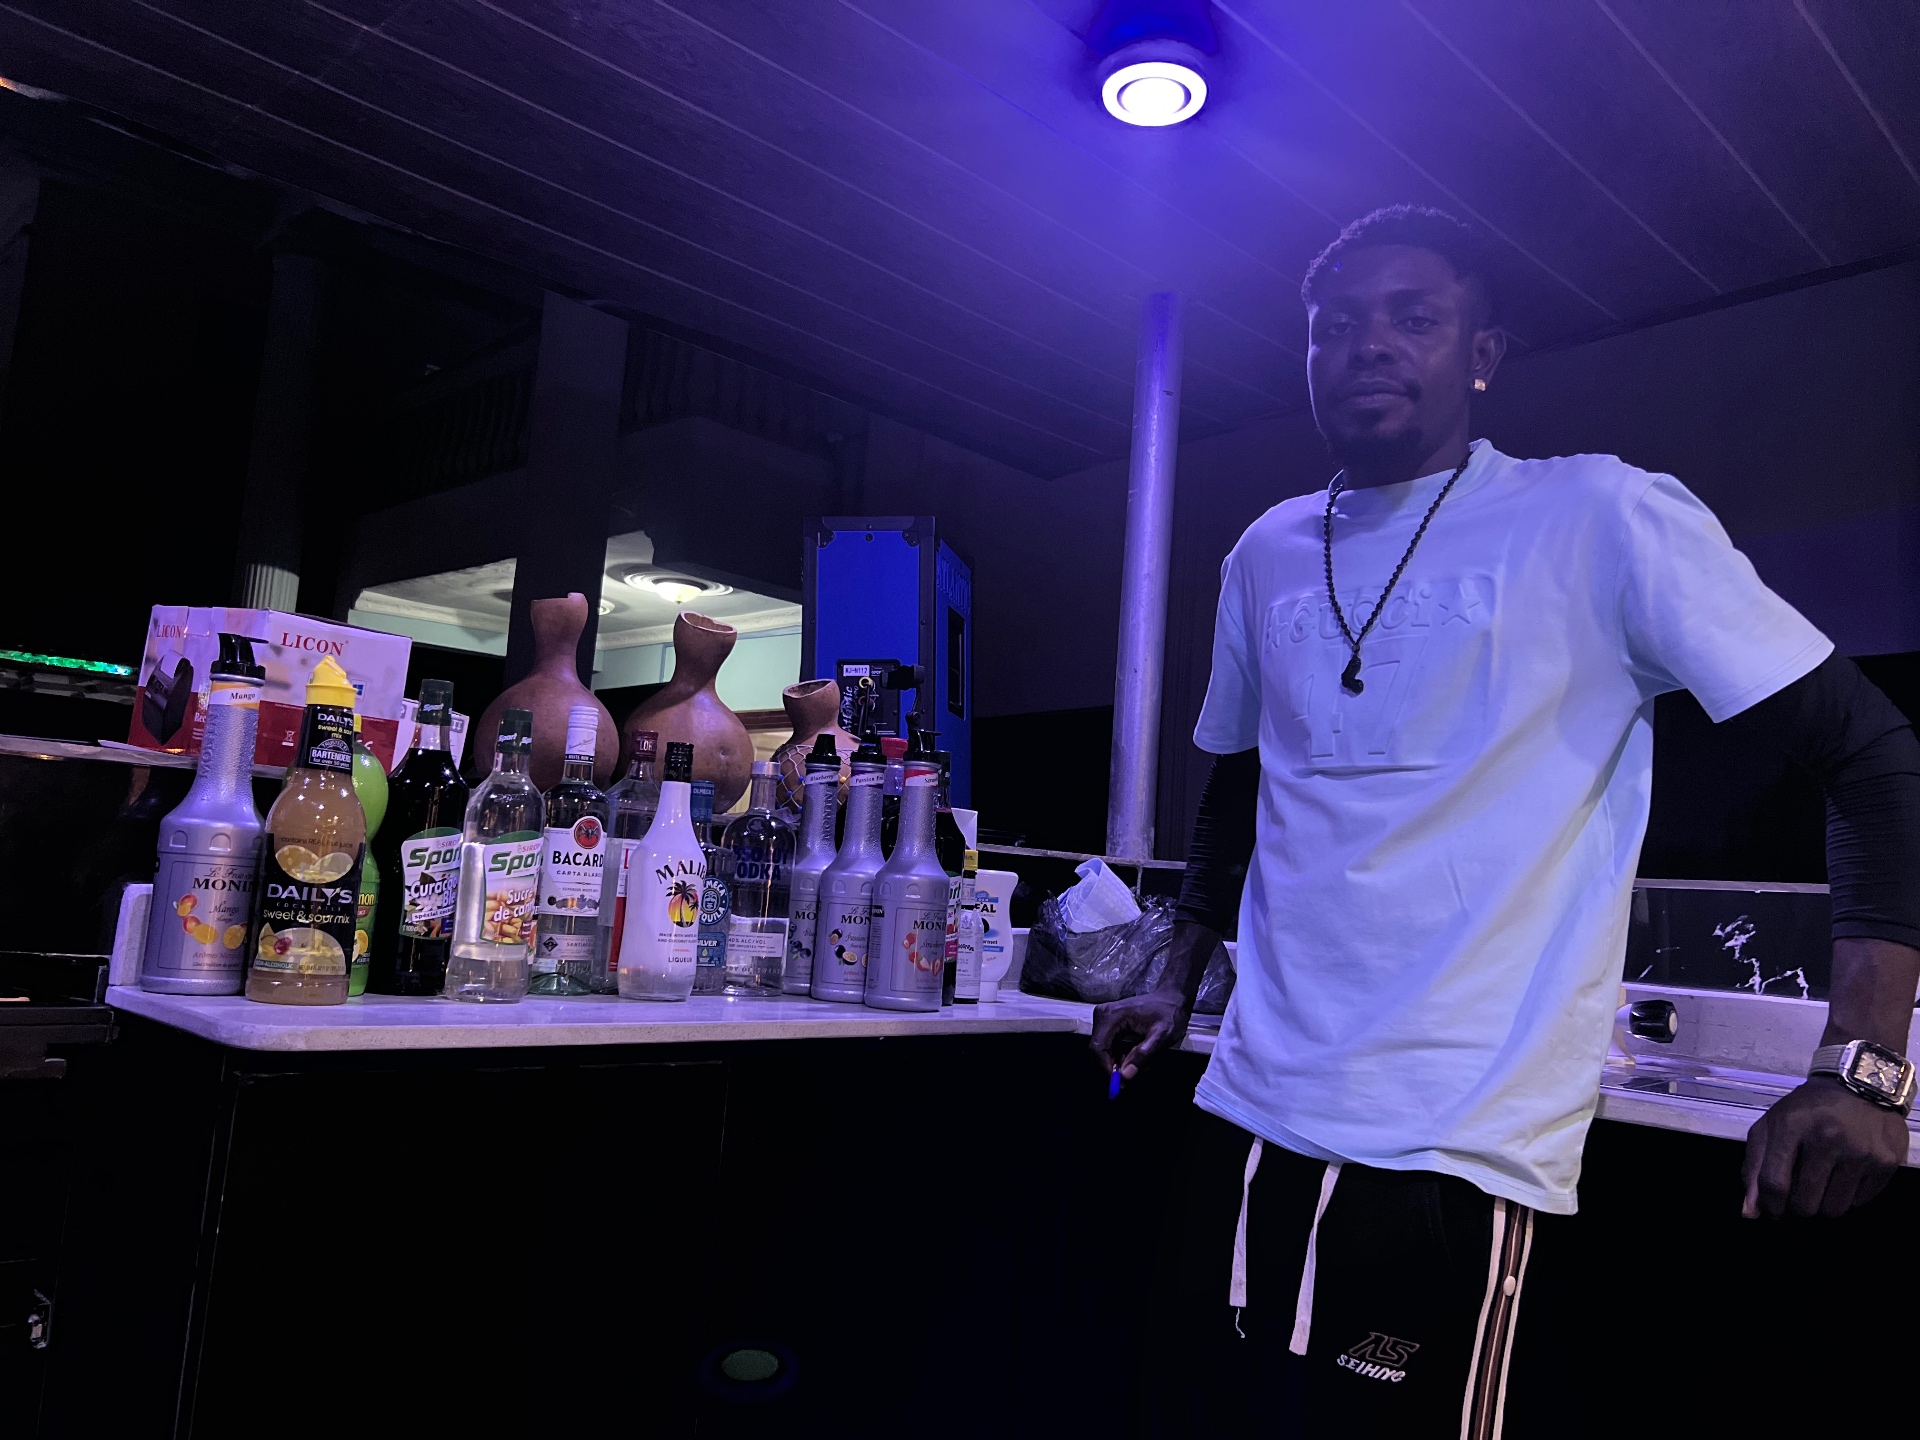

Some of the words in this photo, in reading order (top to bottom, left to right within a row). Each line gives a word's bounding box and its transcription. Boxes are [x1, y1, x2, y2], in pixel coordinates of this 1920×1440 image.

[156, 624, 182, 638] LICON
[281, 631, 345, 656] LICON
[229, 692, 256, 701] Mango
[556, 869, 581, 877] CARTA
[266, 883, 353, 906] DAILY'S
[209, 901, 240, 916] Mango
[276, 901, 341, 912] COCKTAILS
[493, 906, 510, 922] de
[263, 909, 294, 920] sweet
[296, 910, 307, 922] &
[308, 914, 333, 923] sour
[333, 913, 350, 924] mix
